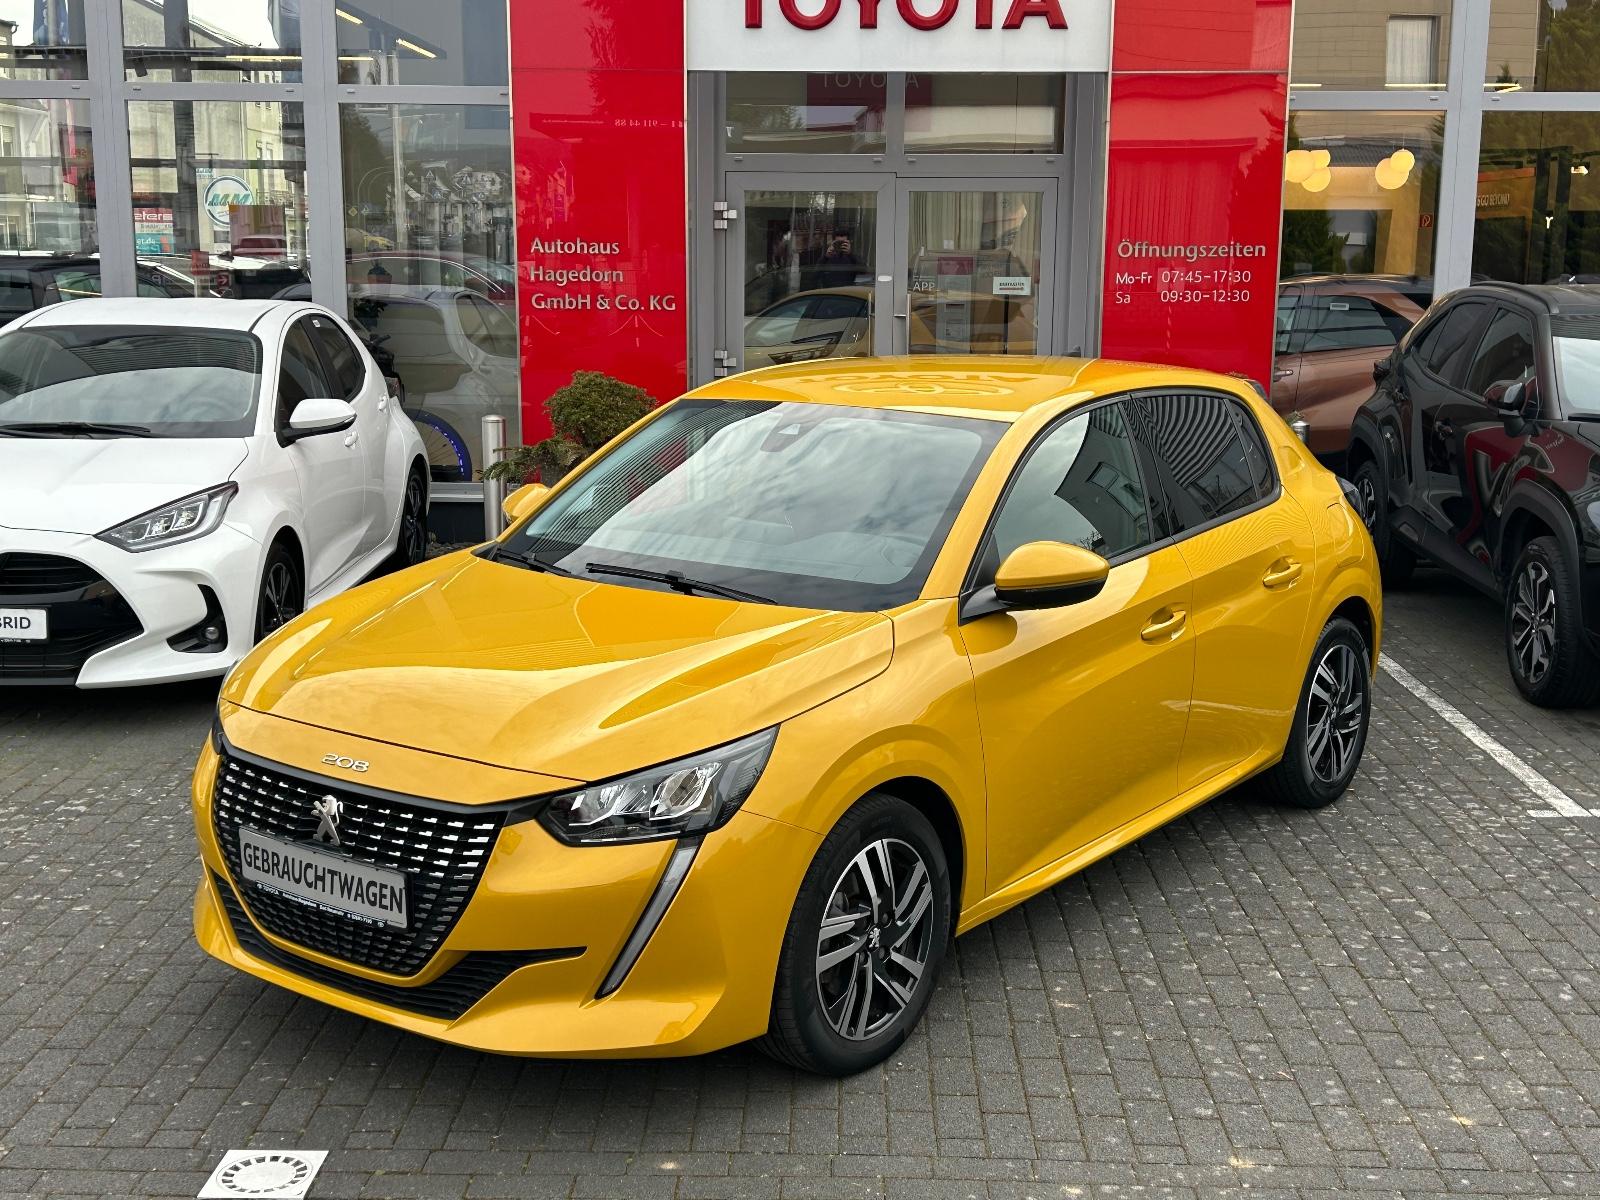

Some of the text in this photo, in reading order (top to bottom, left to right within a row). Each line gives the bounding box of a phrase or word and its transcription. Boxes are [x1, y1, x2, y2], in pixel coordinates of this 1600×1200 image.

[530, 238, 621, 255] Autohaus
[1117, 239, 1267, 263] Öffnungszeiten
[530, 265, 624, 287] Hagedorn
[1115, 270, 1252, 285] Mo-Fr 07:45-17:30
[531, 293, 677, 311] GmbH & Co. KG
[1115, 289, 1250, 305] Sa 09:30-12:30
[0, 616, 31, 629] RID
[322, 754, 369, 772] 208
[243, 842, 405, 914] GEBRAUCHTWAGEN
